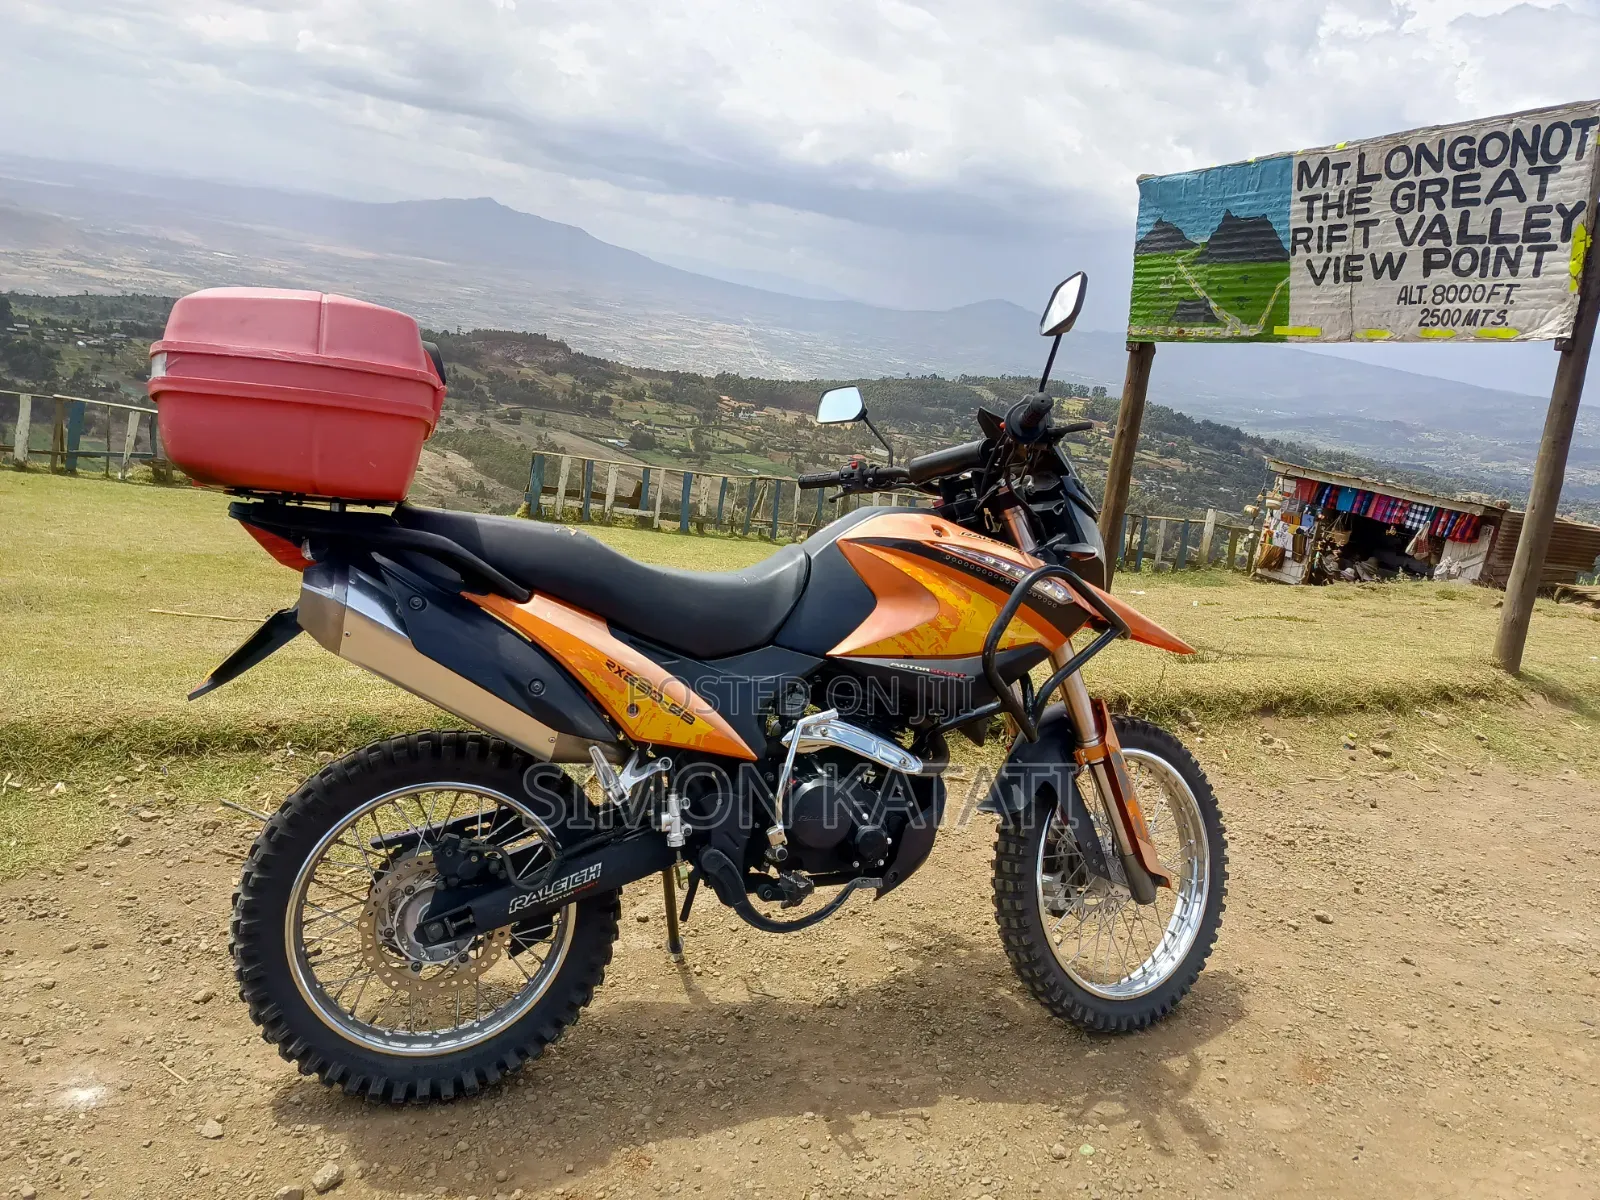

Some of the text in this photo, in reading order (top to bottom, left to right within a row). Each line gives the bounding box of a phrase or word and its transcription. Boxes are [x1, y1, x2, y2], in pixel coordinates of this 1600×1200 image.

[1357, 116, 1600, 184] LONGONOT
[1300, 165, 1561, 223] THE GREAT
[1291, 201, 1587, 256] RIFT VALLEY
[1306, 244, 1558, 286] VIEW POINT
[1396, 284, 1428, 305] ALT.
[508, 862, 602, 915] RALEIGH
